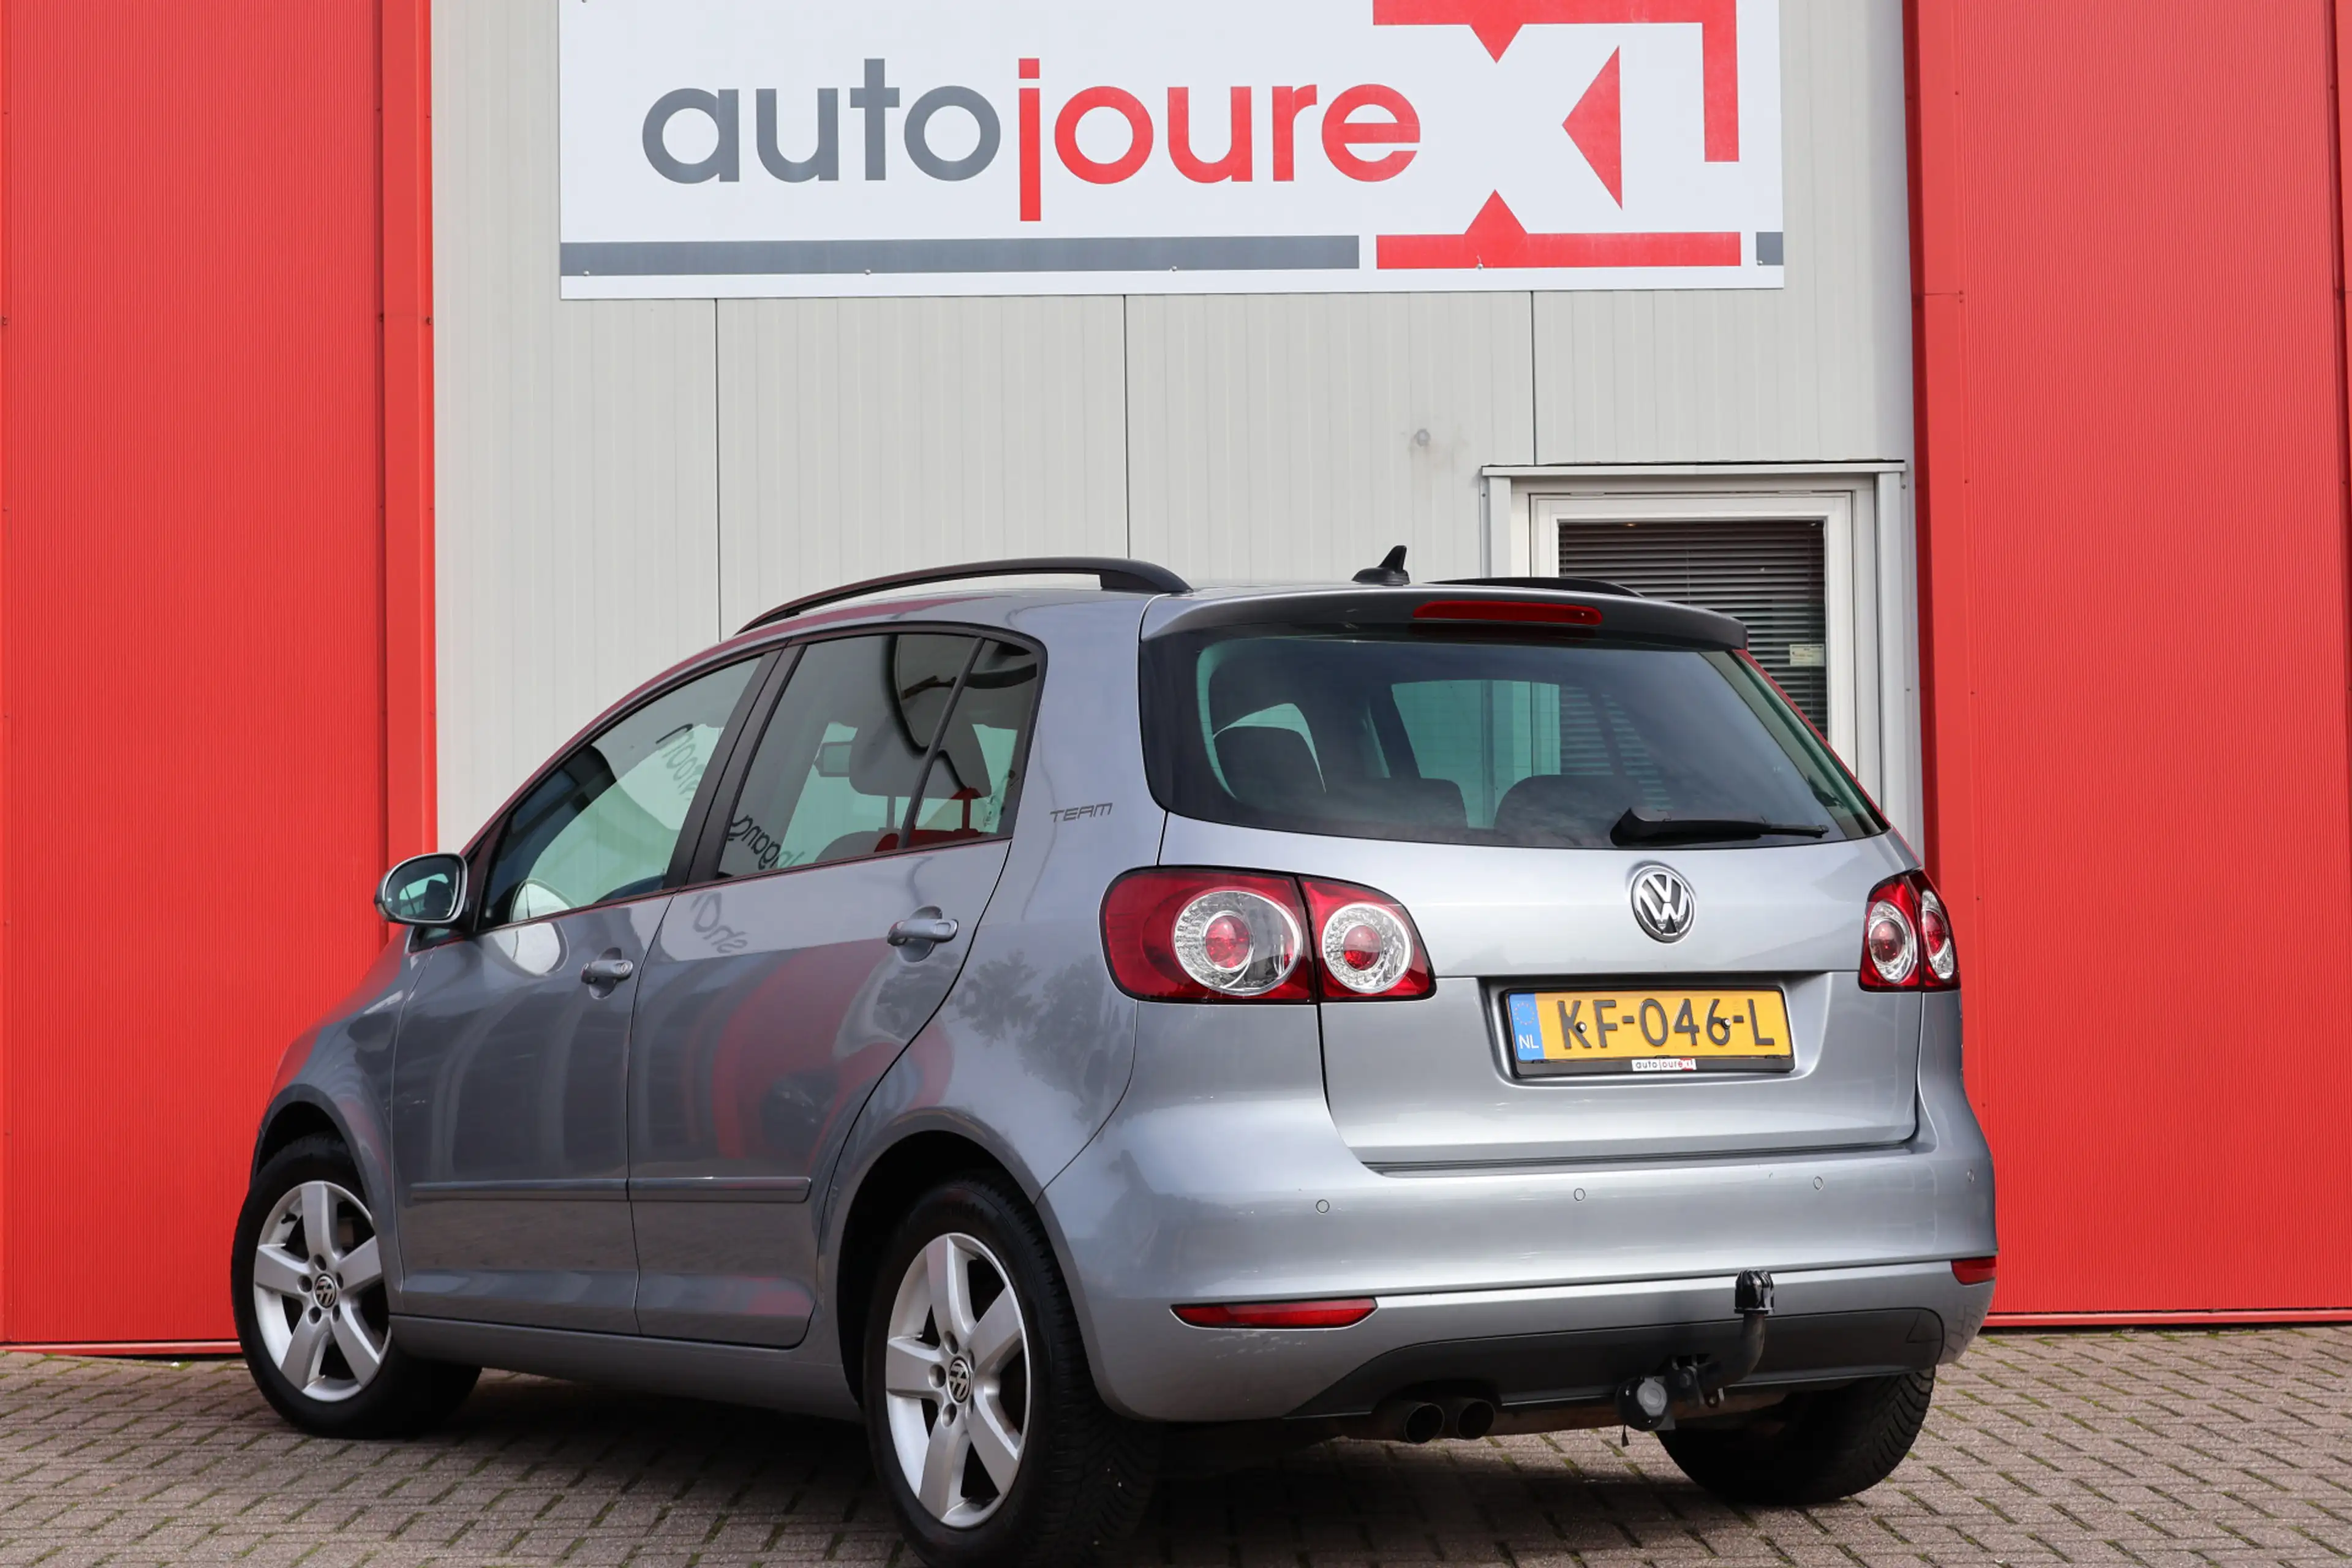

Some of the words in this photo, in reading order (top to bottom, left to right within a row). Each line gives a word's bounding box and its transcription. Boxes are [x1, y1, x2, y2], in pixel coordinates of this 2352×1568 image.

[1050, 802, 1114, 823] TEAM
[1558, 998, 1775, 1049] KF-046-L
[1519, 1034, 1539, 1050] NL
